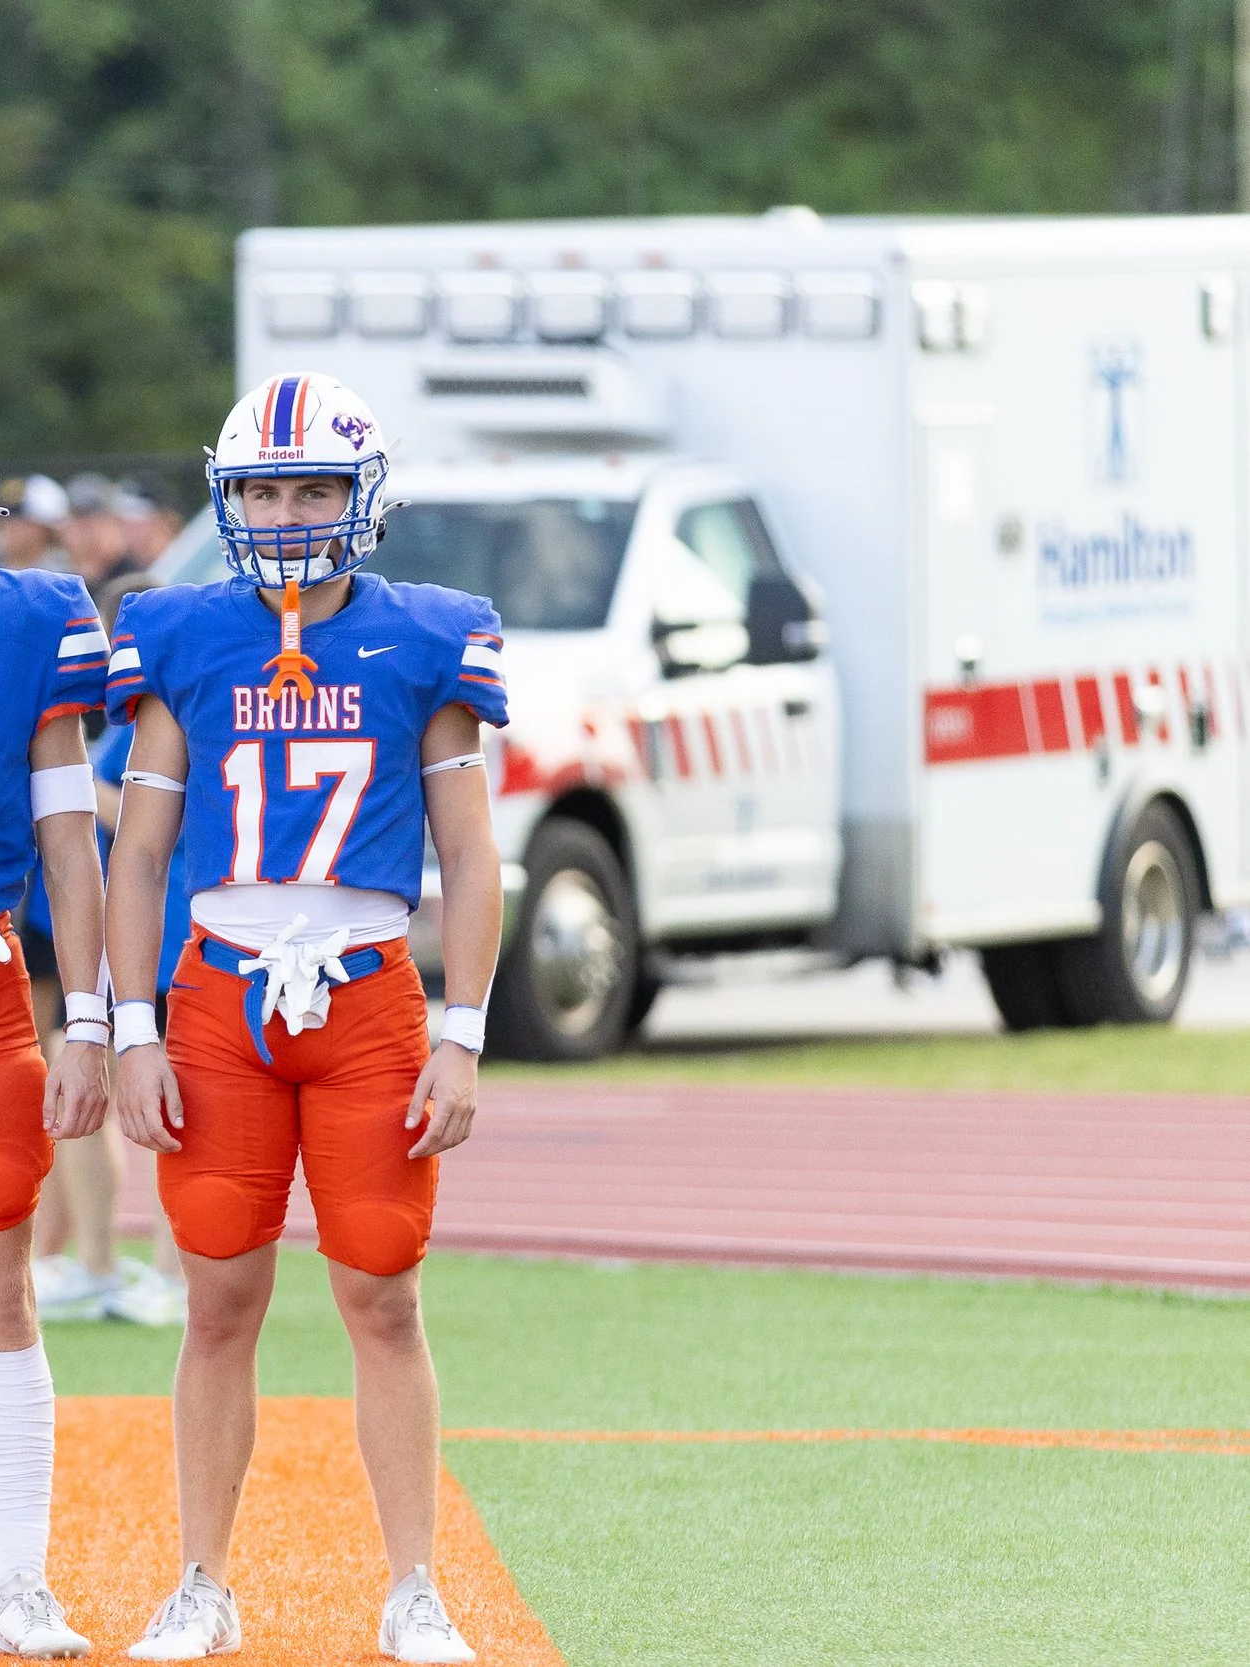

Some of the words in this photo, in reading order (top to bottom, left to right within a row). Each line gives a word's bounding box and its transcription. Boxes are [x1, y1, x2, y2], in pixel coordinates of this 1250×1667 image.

[258, 449, 304, 461] Riddell
[284, 611, 299, 650] NXTRND
[233, 685, 362, 731] BRUINS
[220, 738, 378, 886] 17
